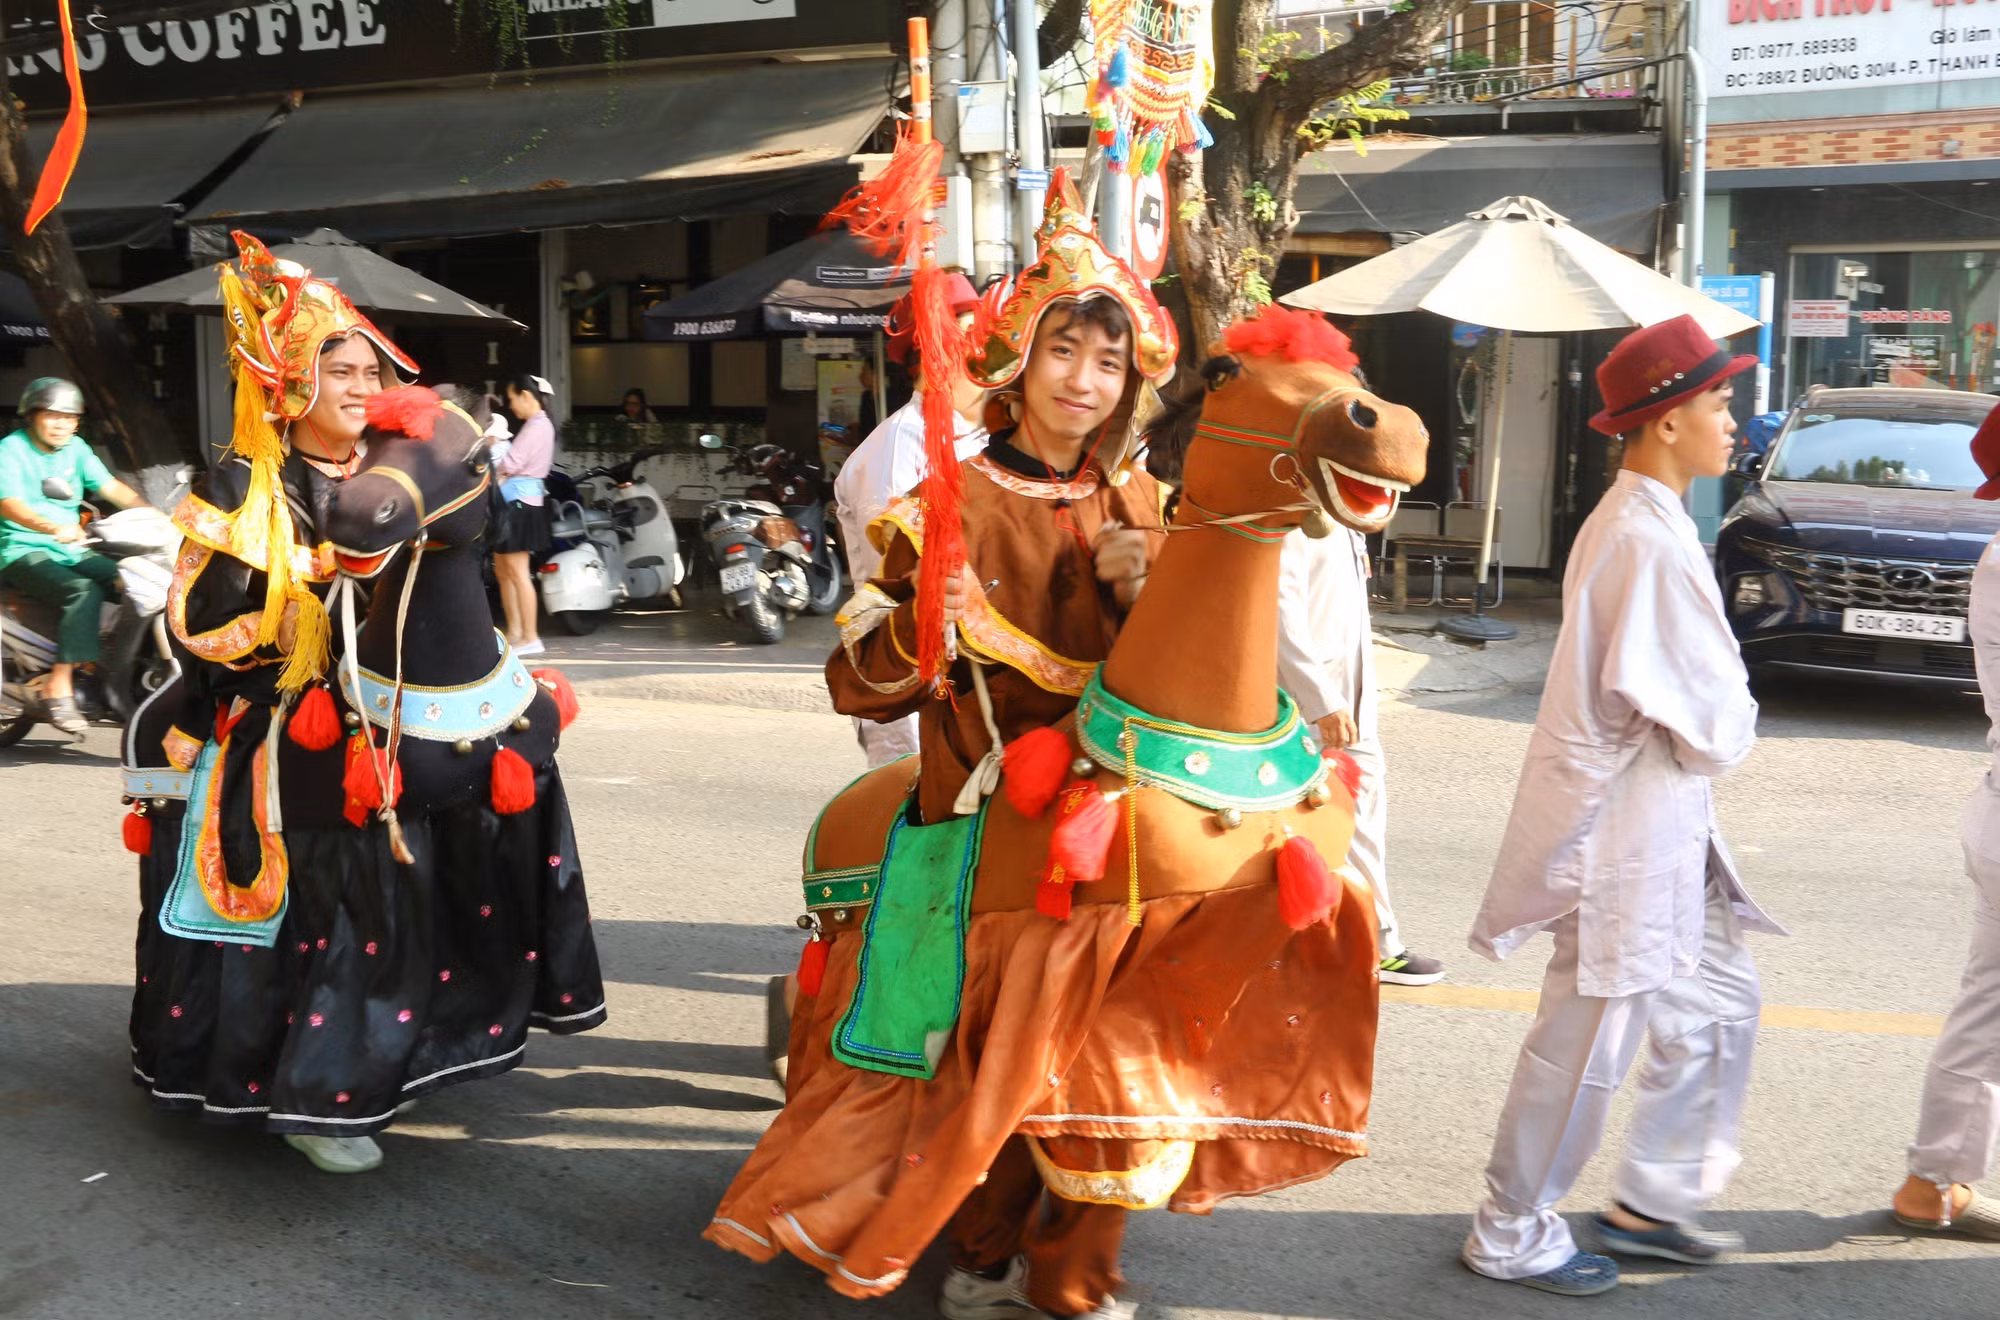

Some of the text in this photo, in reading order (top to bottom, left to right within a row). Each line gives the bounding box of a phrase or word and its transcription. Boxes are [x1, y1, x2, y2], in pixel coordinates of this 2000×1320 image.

[117, 0, 387, 66] COFFEE
[1930, 27, 1957, 45] Giờ
[1962, 26, 1991, 43] làm
[1731, 37, 1857, 61] ĐT: 0977.689938
[1725, 73, 1752, 88] ĐC:
[1756, 69, 1797, 86] 288/2
[1802, 62, 1859, 84] ĐƯỜNG
[1865, 61, 1896, 78] 30/4
[1927, 54, 1989, 74] THANH
[1861, 308, 1909, 323] PHÒNG
[1911, 308, 1952, 323] RĂNG
[672, 321, 699, 336] 1900
[1856, 614, 1953, 636] 60K-384.25
